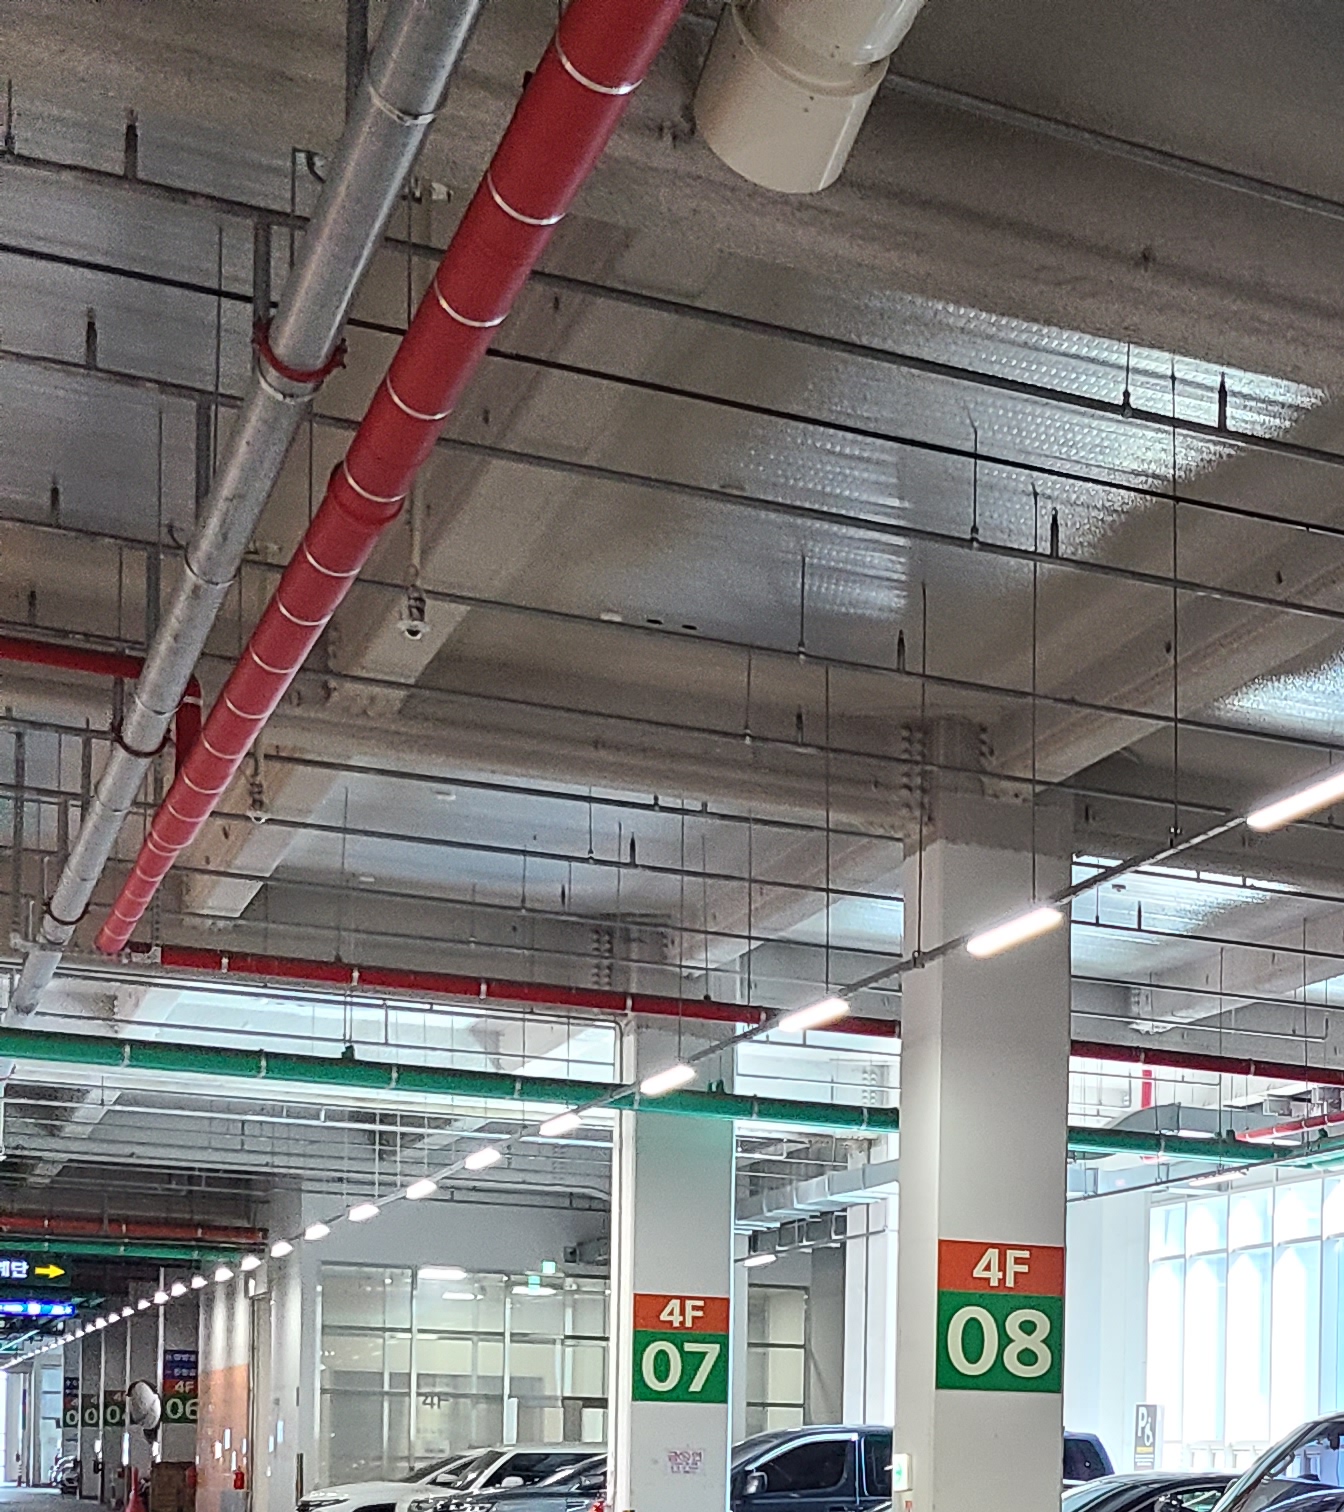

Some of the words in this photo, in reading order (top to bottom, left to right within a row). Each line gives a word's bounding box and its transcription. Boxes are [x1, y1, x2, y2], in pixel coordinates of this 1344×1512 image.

[973, 1248, 1030, 1288] 4F
[659, 1299, 704, 1327] 4F
[947, 1305, 1051, 1377] 08
[642, 1341, 720, 1392] 07
[174, 1381, 194, 1393] 4F
[166, 1398, 197, 1420] 06
